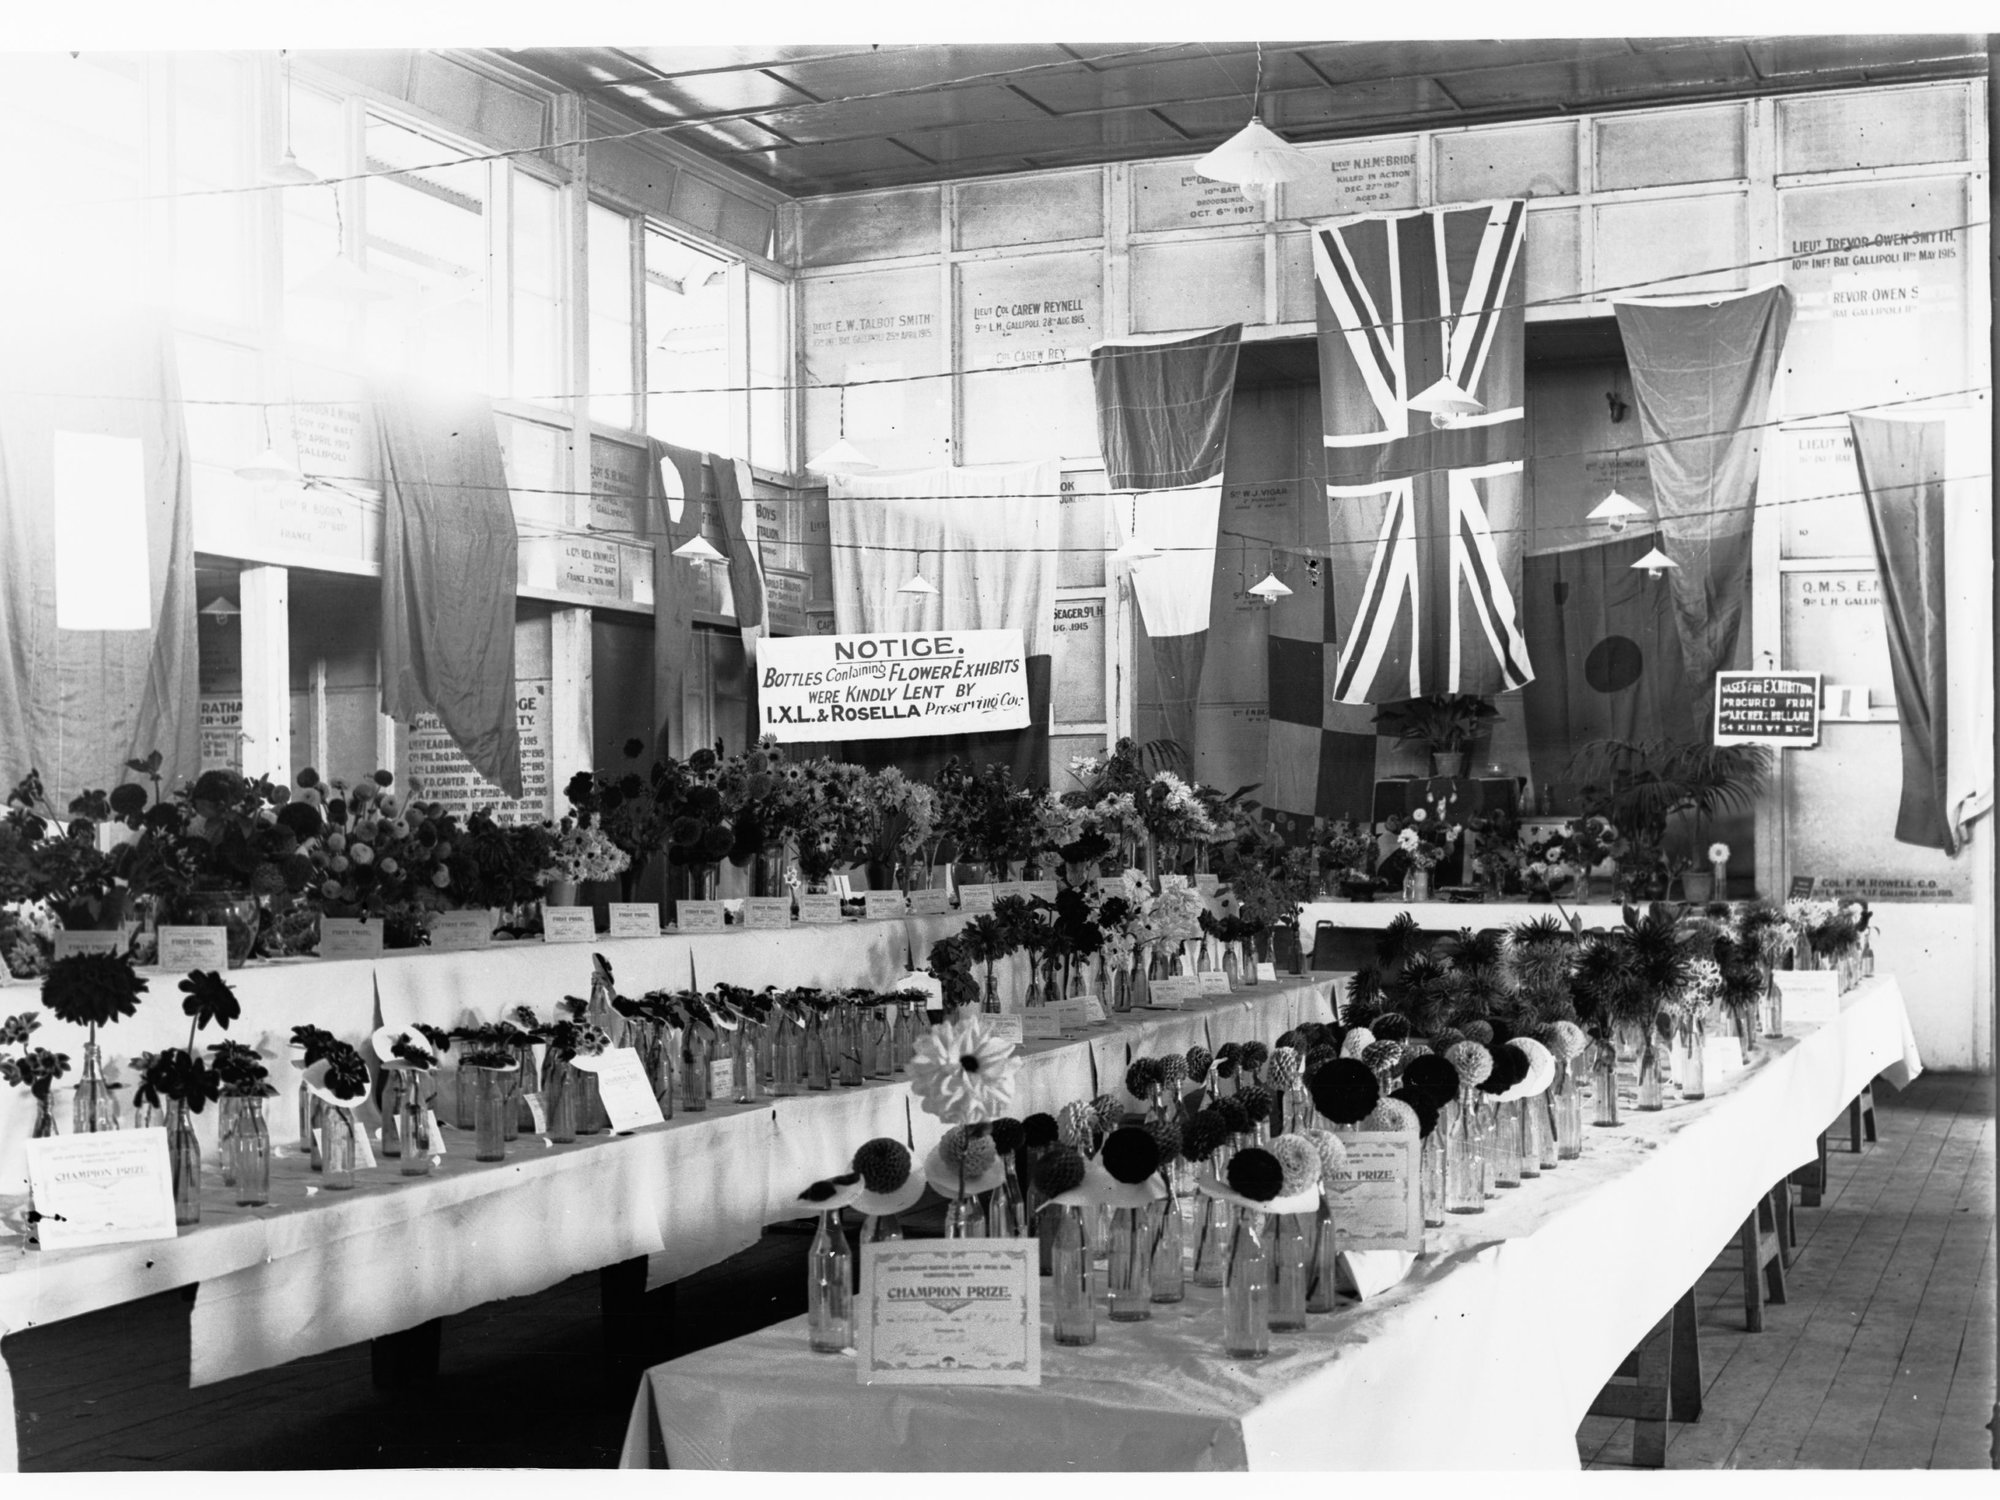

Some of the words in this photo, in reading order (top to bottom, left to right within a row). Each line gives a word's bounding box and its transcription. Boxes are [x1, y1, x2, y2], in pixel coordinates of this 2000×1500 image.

[1336, 175, 1364, 183] KILLED
[1380, 170, 1411, 178] ACTION
[1234, 205, 1254, 214] 1917
[1826, 237, 1870, 252] TREVOR
[1874, 233, 1909, 247] OWEN
[1852, 254, 1900, 266] GALLIPOLI
[1918, 250, 1935, 261] MAY
[1938, 247, 1957, 259] 1915
[1872, 287, 1907, 301] OWEN
[1011, 302, 1041, 317] CAREW
[1043, 299, 1084, 314] REYNELL
[859, 316, 895, 331] TALBOT
[898, 313, 931, 327] SMITH
[1005, 319, 1041, 330] GALLIPOLI
[1014, 350, 1044, 362] CAREW
[756, 503, 777, 521] BOYS
[834, 636, 965, 660] NOTICE.
[762, 667, 823, 688] BOTTLES
[826, 661, 886, 682] Containing
[888, 662, 953, 682] FLOWER
[952, 659, 1020, 679] EXHIBITS
[808, 689, 841, 704] WERE
[846, 685, 898, 702] KINDLY
[902, 683, 945, 701] LENT
[955, 682, 976, 697] BY
[816, 708, 829, 722] &
[831, 703, 921, 722] ROSELLA
[924, 696, 999, 716] Preserving
[1723, 697, 1776, 708] PROCURED
[1785, 698, 1813, 708] FROM
[54, 1168, 113, 1183] CHAMPION
[1356, 1170, 1396, 1181] PRIZE.
[887, 1286, 962, 1299] CHAMPION
[966, 1285, 1012, 1298] PRIZE.
